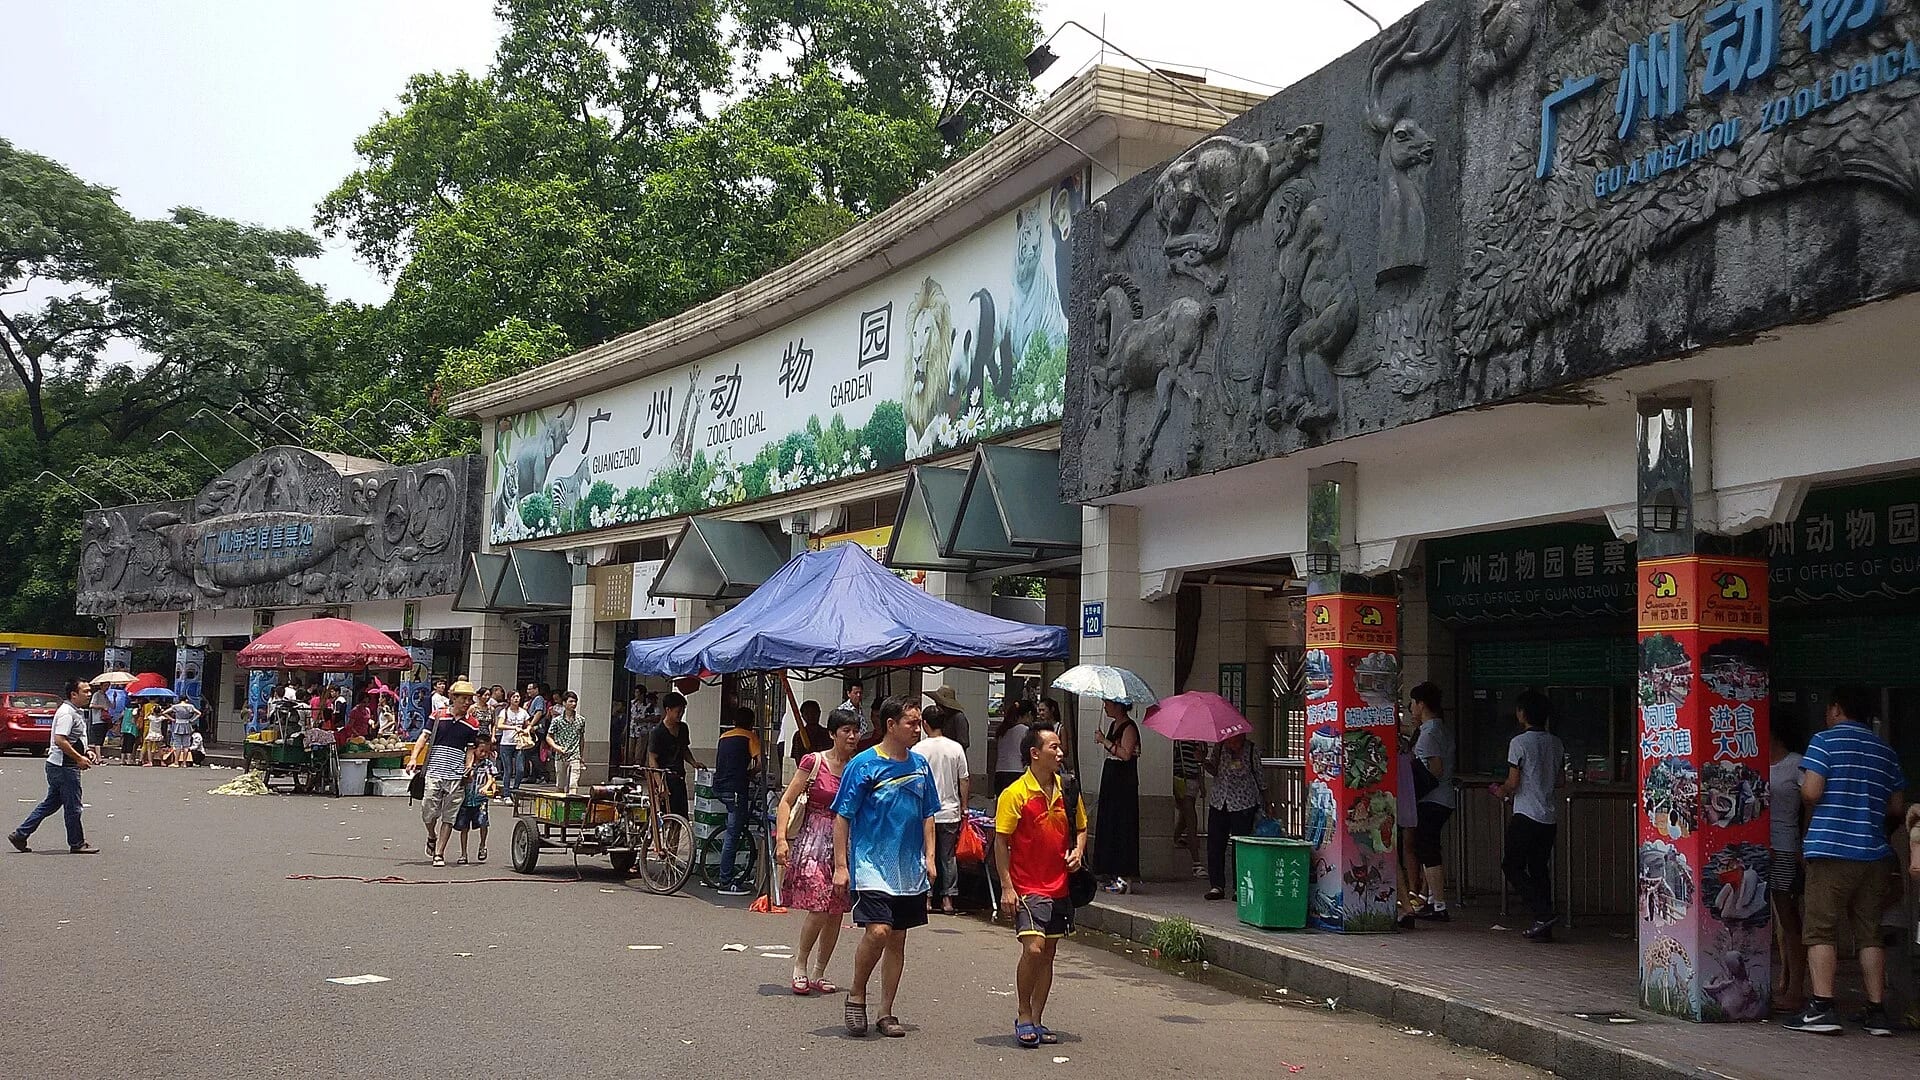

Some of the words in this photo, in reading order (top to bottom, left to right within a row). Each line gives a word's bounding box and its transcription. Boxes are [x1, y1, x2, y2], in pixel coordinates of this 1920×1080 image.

[1594, 117, 1742, 198] GUANGZHOU
[581, 300, 894, 455] 广州动物园
[592, 445, 641, 475] GUANGZHOU
[706, 410, 767, 448] ZOOLOGICAL
[829, 371, 873, 409] GARDEN
[203, 521, 314, 556] 广州海洋馆售票处
[1800, 561, 1855, 581] OFFICE
[1861, 558, 1883, 576] OF
[1444, 592, 1481, 608] TICKET
[1485, 589, 1521, 605] OFFICE
[1525, 588, 1542, 603] OF
[1545, 582, 1619, 601] GUANGZHOU
[1086, 616, 1099, 633] 120
[1641, 607, 1689, 622] 广州动物园
[1701, 609, 1763, 625] 广州动物园
[1345, 705, 1395, 728] 蝴蝶馆
[1642, 702, 1678, 733] 饲喂
[1710, 703, 1755, 733] 进食
[1640, 728, 1692, 760] 长颈鹿
[1712, 730, 1759, 760] 大观
